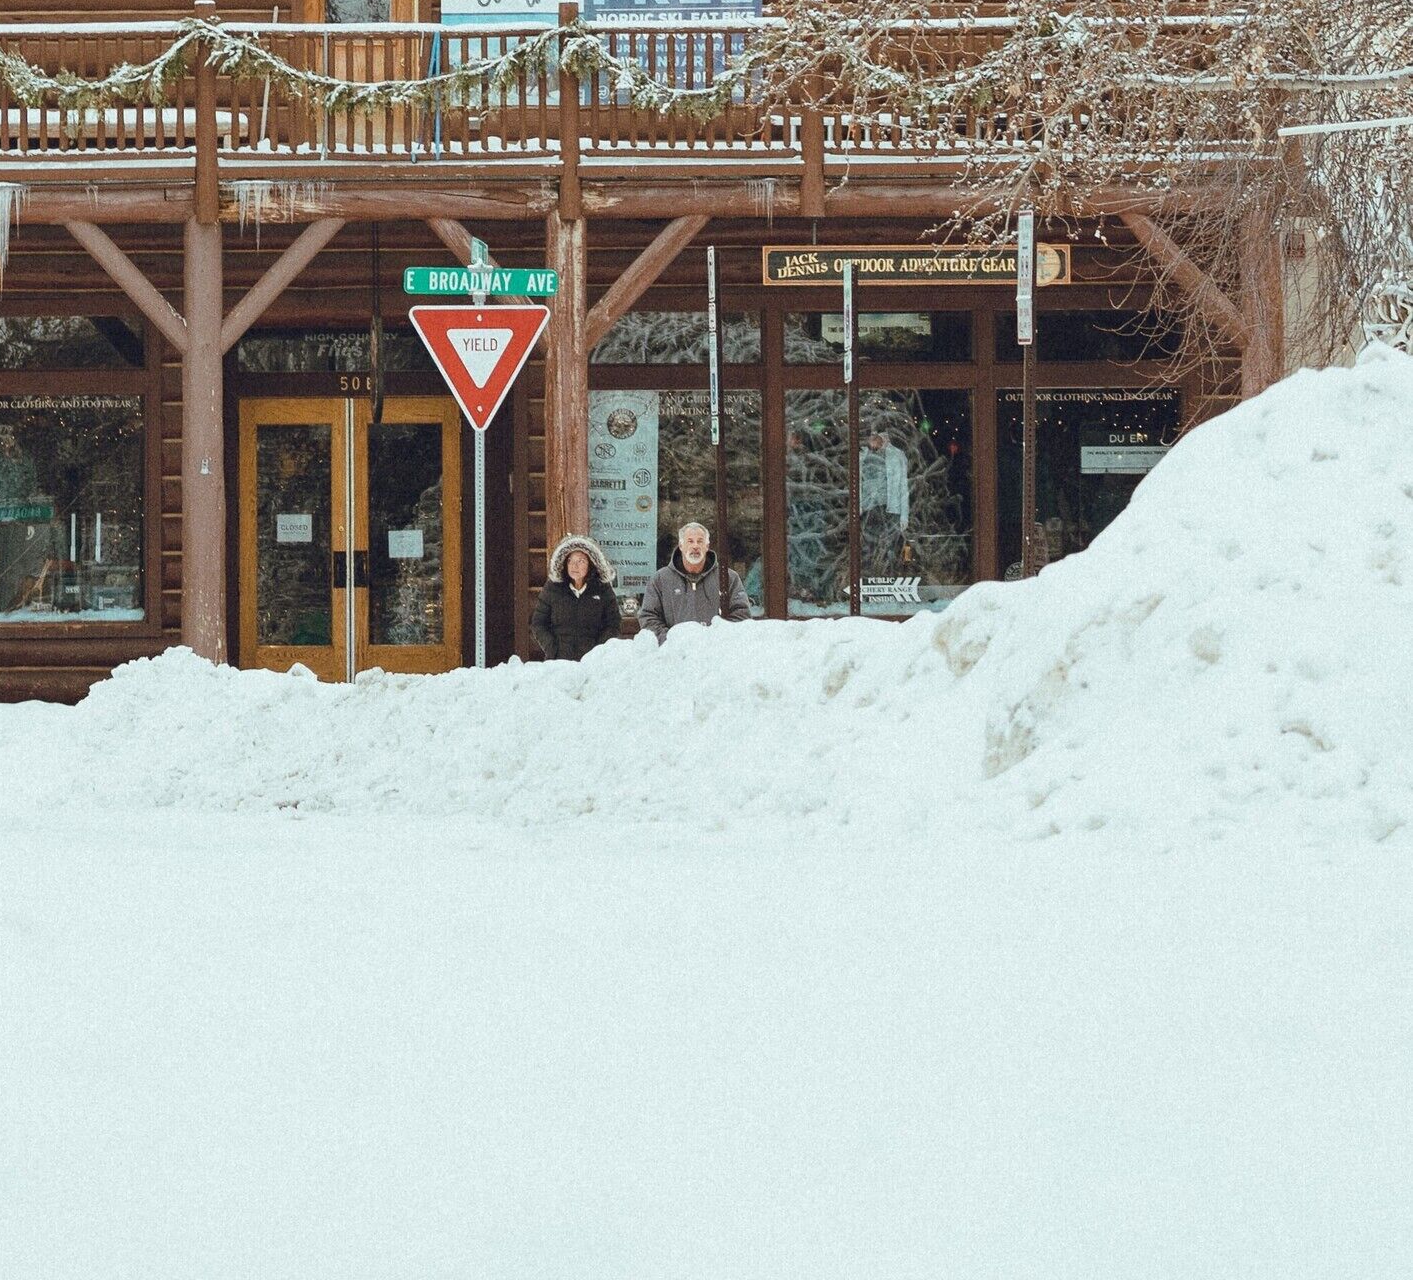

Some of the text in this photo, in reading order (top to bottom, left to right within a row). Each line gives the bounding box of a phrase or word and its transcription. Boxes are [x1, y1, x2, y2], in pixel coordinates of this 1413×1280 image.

[785, 252, 819, 266] JACK
[899, 257, 978, 273] ADVENTURE
[982, 257, 1017, 273] GEAR
[777, 262, 829, 279] DENNIS
[406, 271, 556, 293] E BROADWAY AVE
[305, 333, 399, 341] HIGH COUNRY
[463, 338, 498, 352] YIELD
[10, 400, 59, 409] CLOTHING
[60, 400, 80, 409] AND
[81, 399, 132, 409] FOOTWEAR
[687, 395, 710, 403] GUID
[723, 395, 753, 403] ERVICE
[1005, 393, 1173, 401] OUTOOR CLOTHING AND FOOTWEAR
